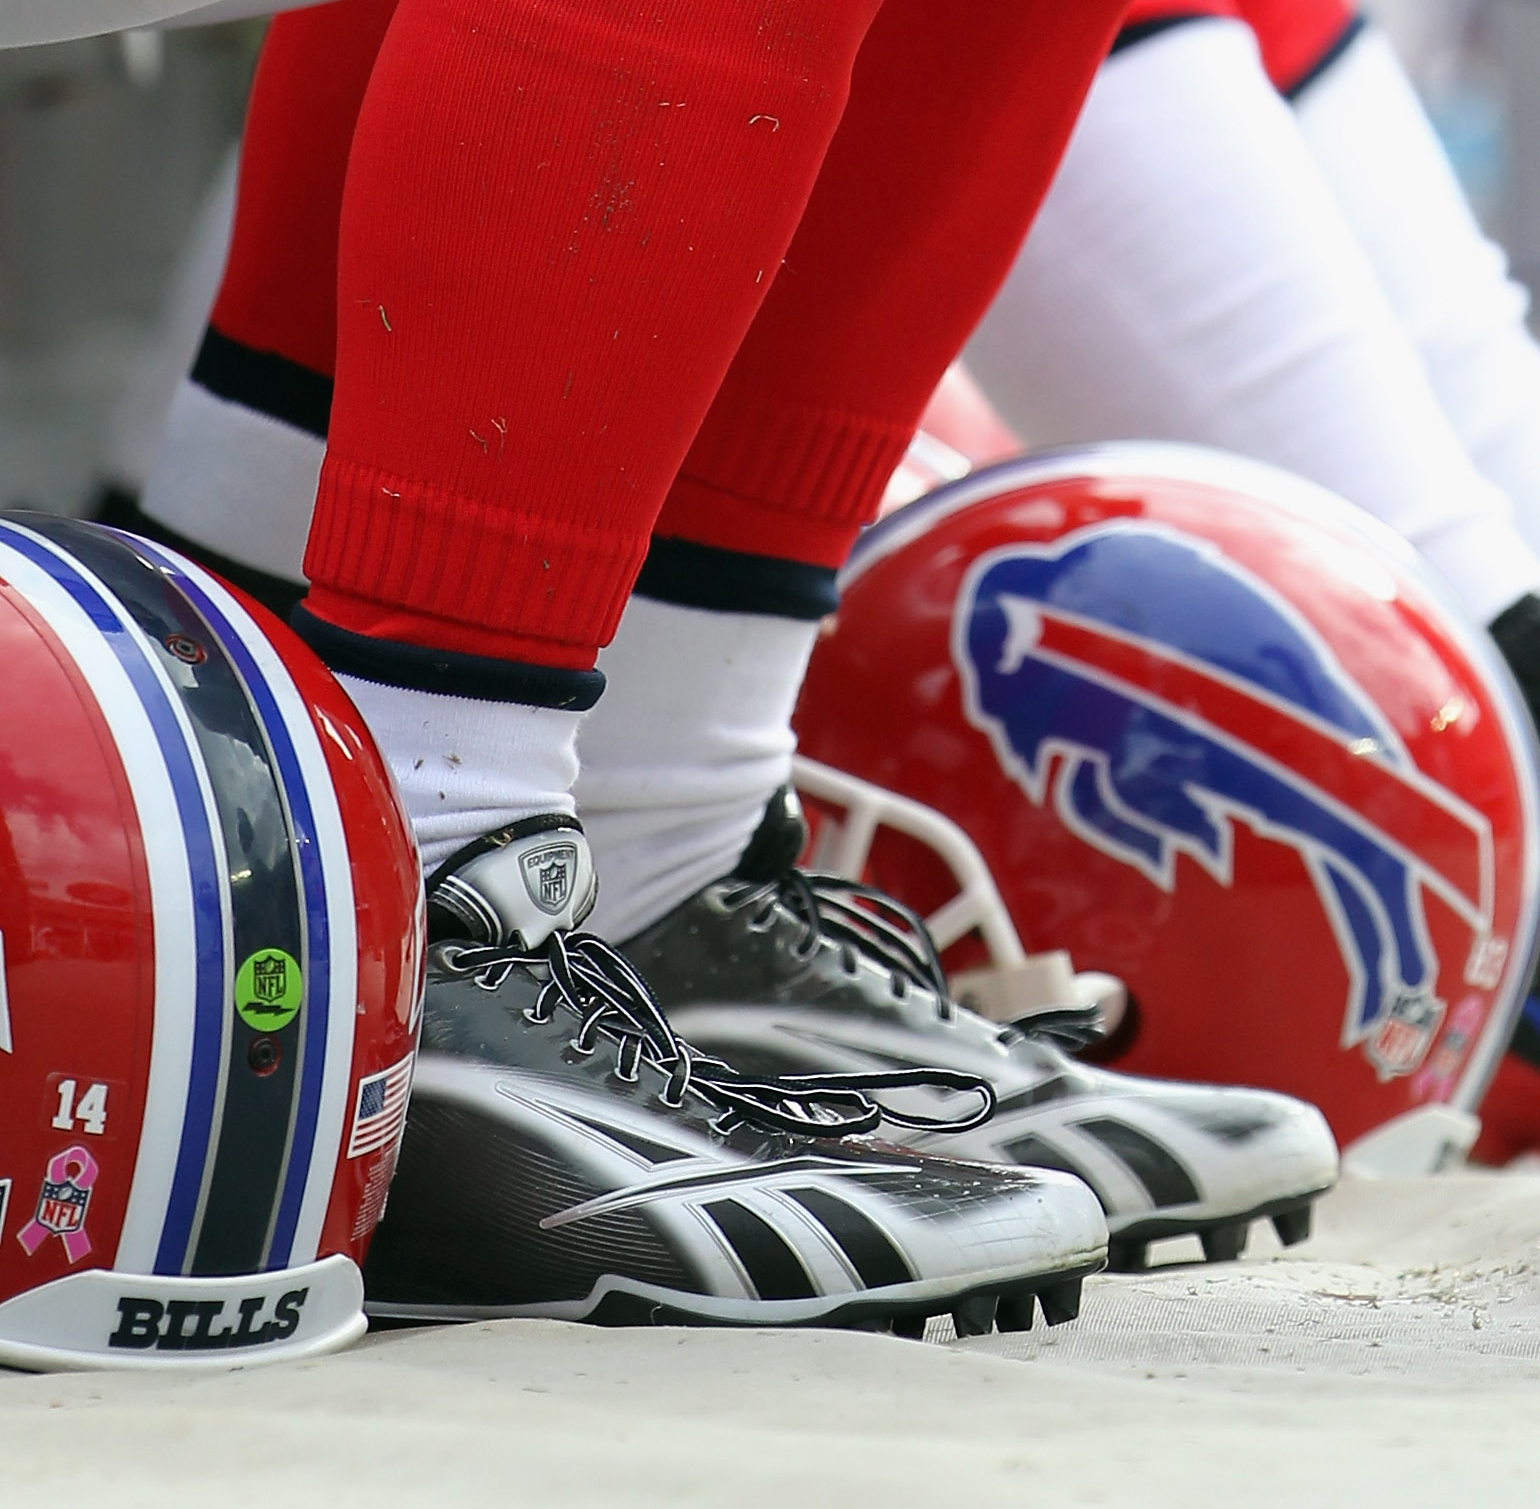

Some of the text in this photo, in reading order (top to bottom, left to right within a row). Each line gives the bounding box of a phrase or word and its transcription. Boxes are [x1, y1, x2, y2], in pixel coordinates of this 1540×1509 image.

[543, 880, 567, 902] NFL
[258, 974, 284, 997] NFL
[52, 1079, 108, 1134] 14
[42, 1200, 80, 1229] NFL
[108, 1287, 310, 1351] BILLS
